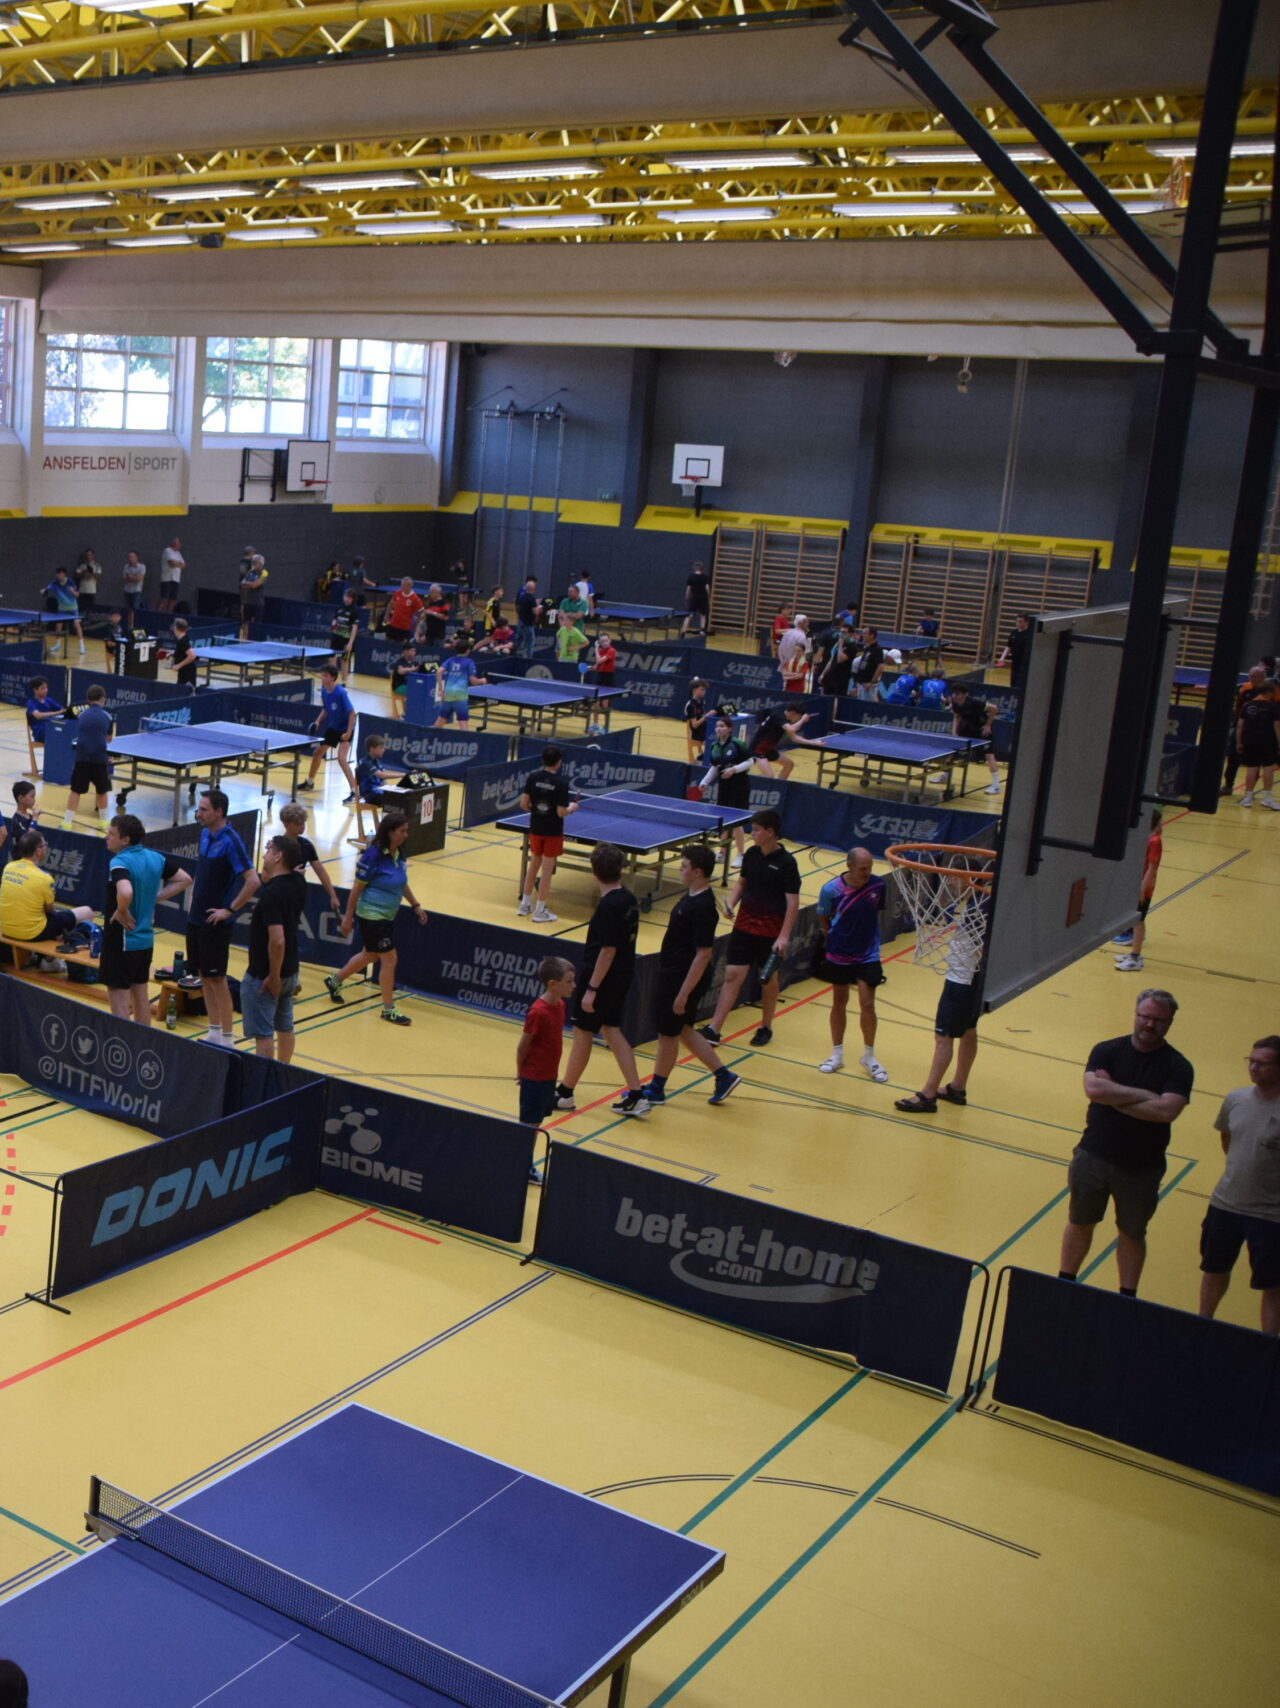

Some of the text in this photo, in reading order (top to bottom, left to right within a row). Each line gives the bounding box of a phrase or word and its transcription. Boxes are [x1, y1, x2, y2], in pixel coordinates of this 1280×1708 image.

[43, 456, 177, 470] ANSFELDEN SPORT
[116, 687, 147, 705] WORLD
[422, 800, 432, 818] 10
[441, 960, 491, 986] TABLE
[473, 946, 539, 977] WORLD
[457, 988, 504, 1011] COMING
[38, 1055, 162, 1124] @ITTFWorld
[320, 1146, 423, 1193] BIOME
[90, 1125, 293, 1248] DONIC
[614, 1197, 880, 1291] bet-at-home
[708, 1259, 764, 1285] .com
